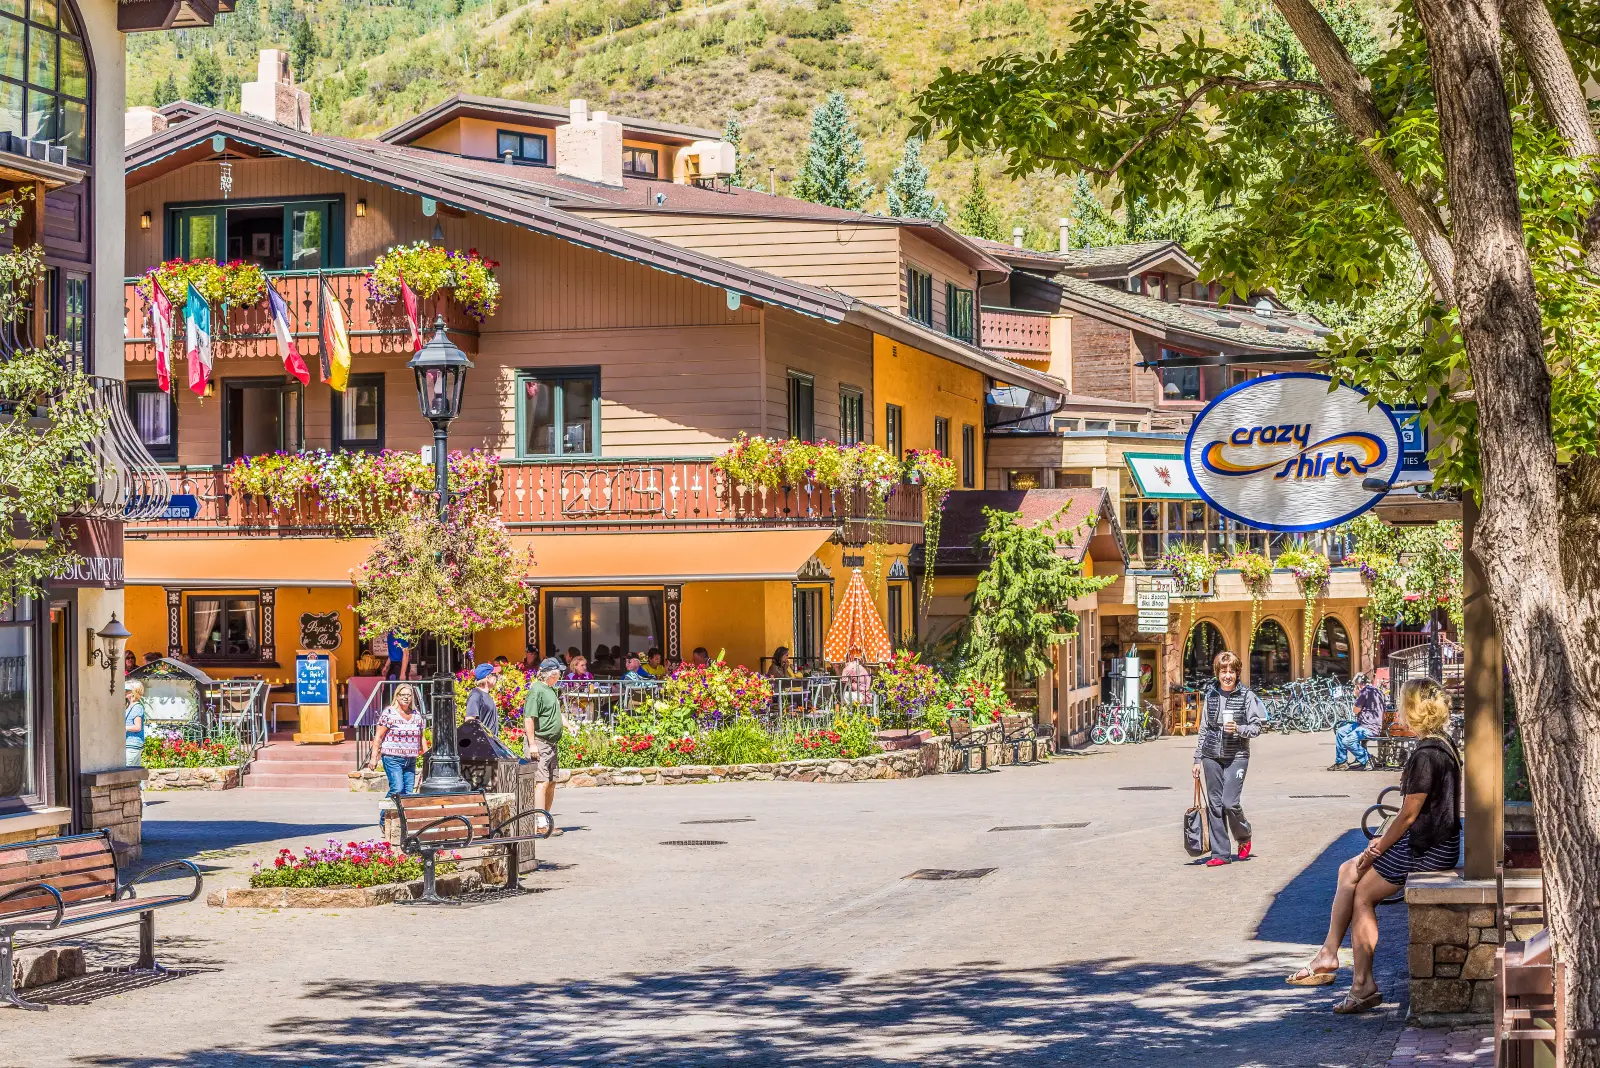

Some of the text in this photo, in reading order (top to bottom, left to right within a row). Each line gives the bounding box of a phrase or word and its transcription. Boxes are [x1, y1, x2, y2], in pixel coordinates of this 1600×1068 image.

[1230, 424, 1312, 448] crazy
[50, 557, 110, 580] ESIGNER
[305, 620, 334, 634] Pepi's
[317, 634, 335, 644] Bar
